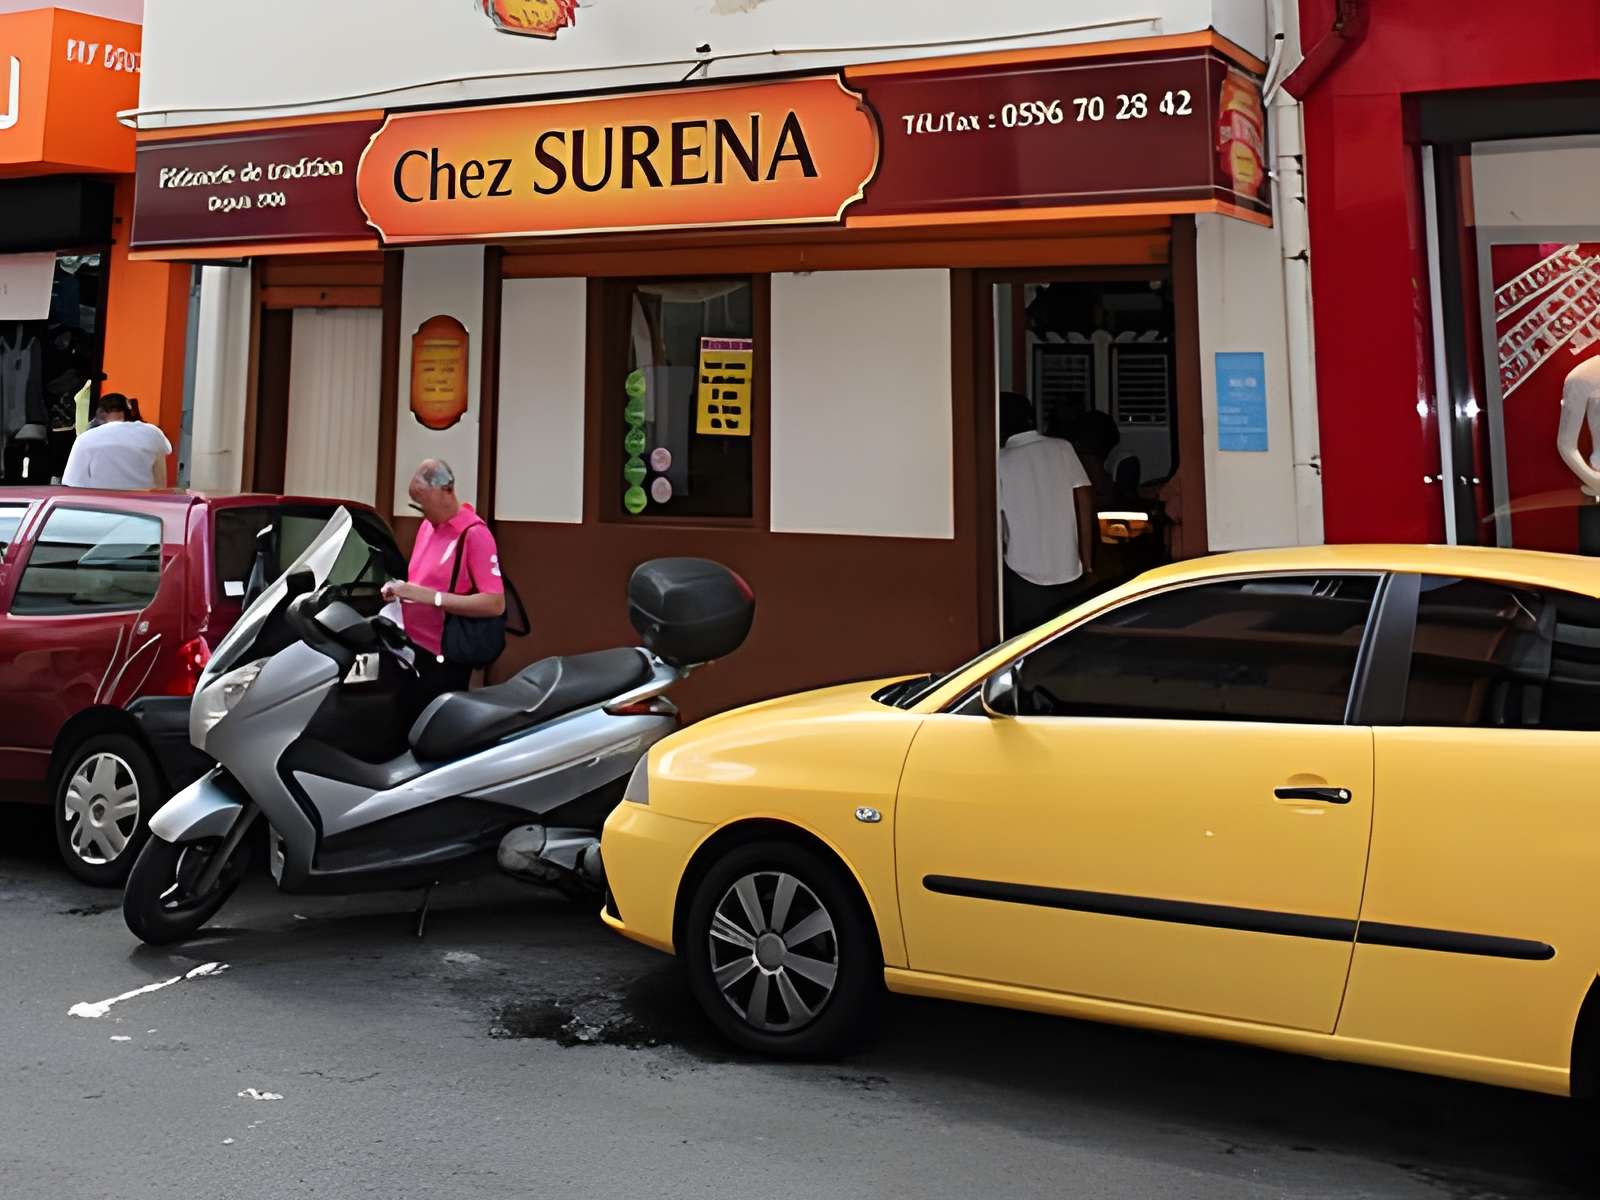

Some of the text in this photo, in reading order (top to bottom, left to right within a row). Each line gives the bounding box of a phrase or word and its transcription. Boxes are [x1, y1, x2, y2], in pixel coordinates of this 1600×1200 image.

[1073, 96, 1105, 122] 70
[1115, 92, 1148, 120] 28
[1159, 89, 1193, 116] 42
[393, 108, 819, 203] Chez SURENA
